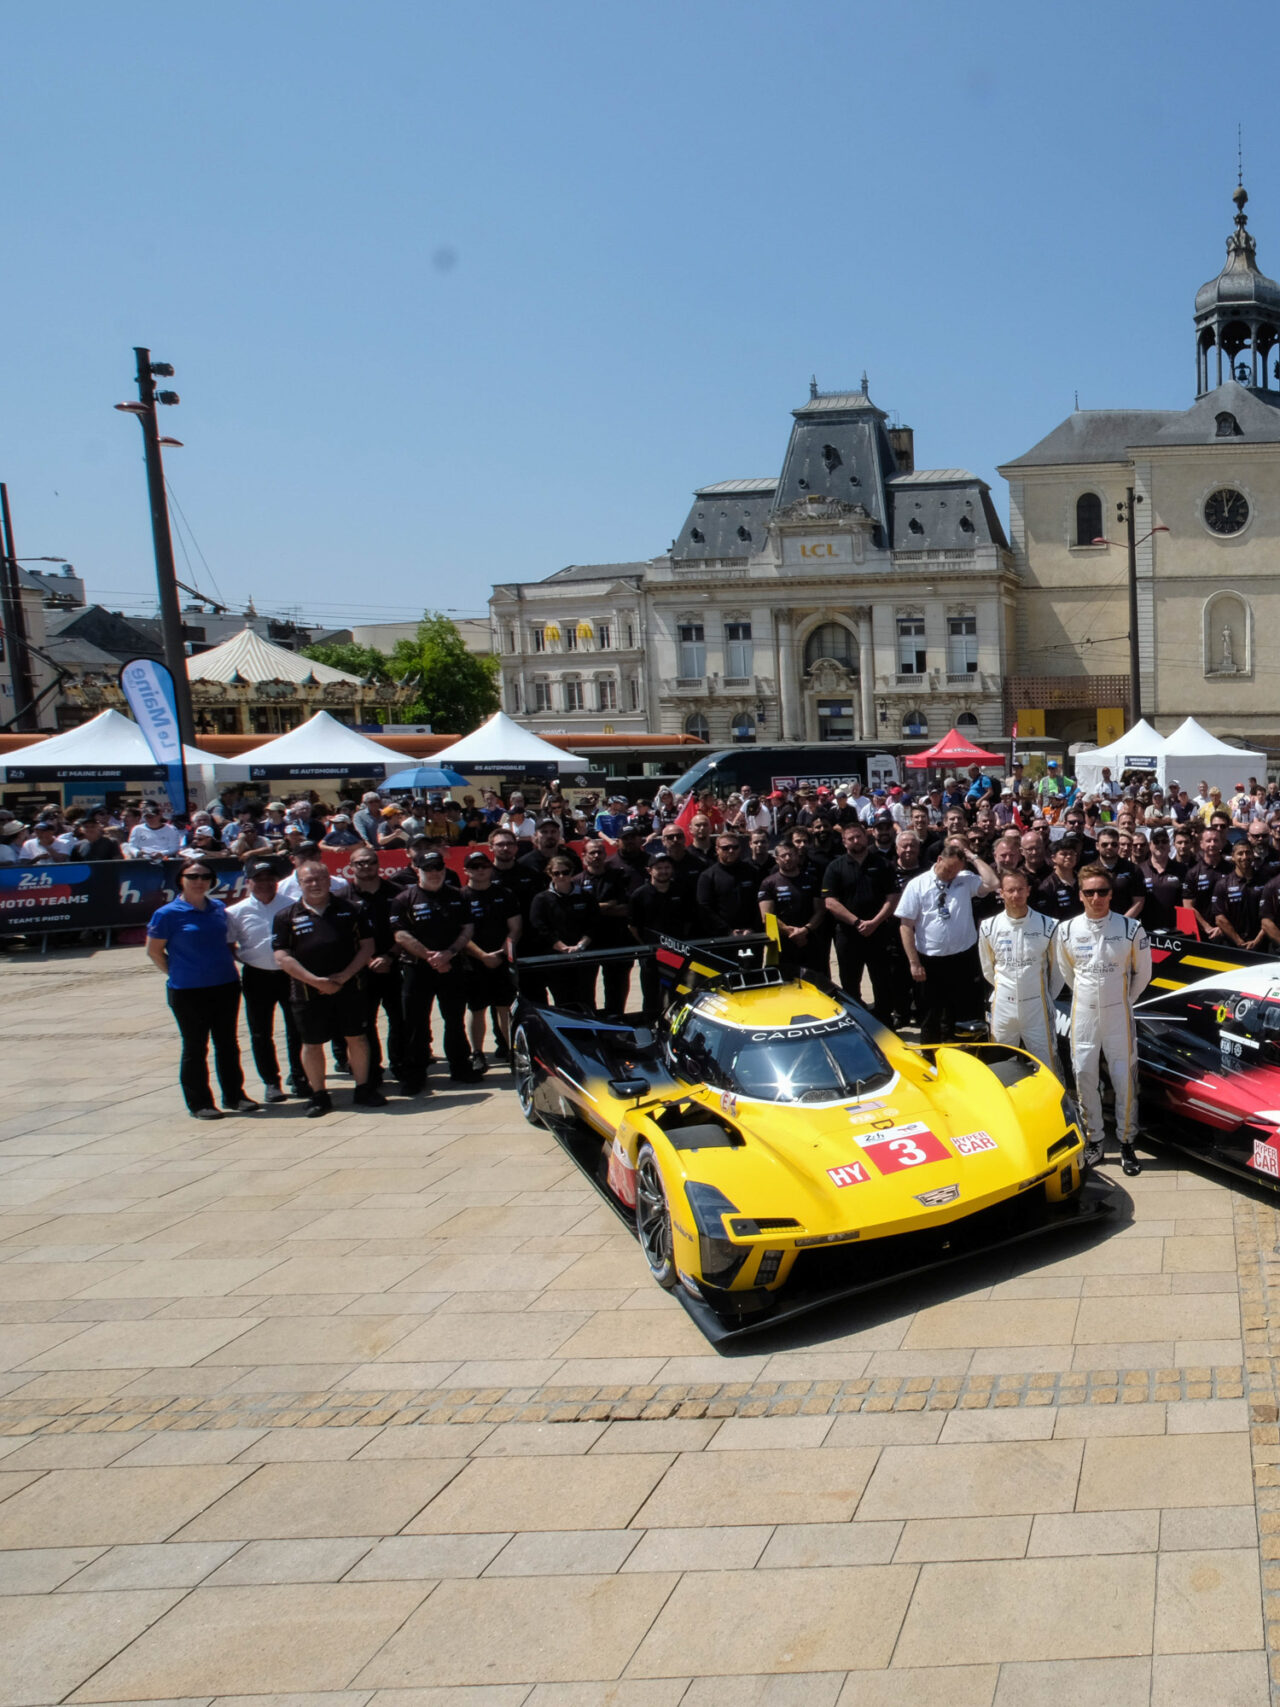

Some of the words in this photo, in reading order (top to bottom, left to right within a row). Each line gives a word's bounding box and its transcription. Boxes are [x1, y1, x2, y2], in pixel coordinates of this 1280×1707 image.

[801, 543, 840, 558] LCL
[39, 895, 88, 906] TEAMS
[8, 916, 40, 925] TEAM'S
[42, 915, 71, 923] PHOTO
[660, 935, 691, 956] CADILLAC
[1149, 936, 1182, 951] LLAC
[752, 1017, 855, 1042] CADILLAC
[952, 1131, 988, 1145] HYPER
[958, 1137, 995, 1153] CAR
[889, 1138, 927, 1166] 3
[1255, 1141, 1277, 1158] HYPER
[1254, 1152, 1278, 1175] CAR
[829, 1163, 864, 1187] HY
